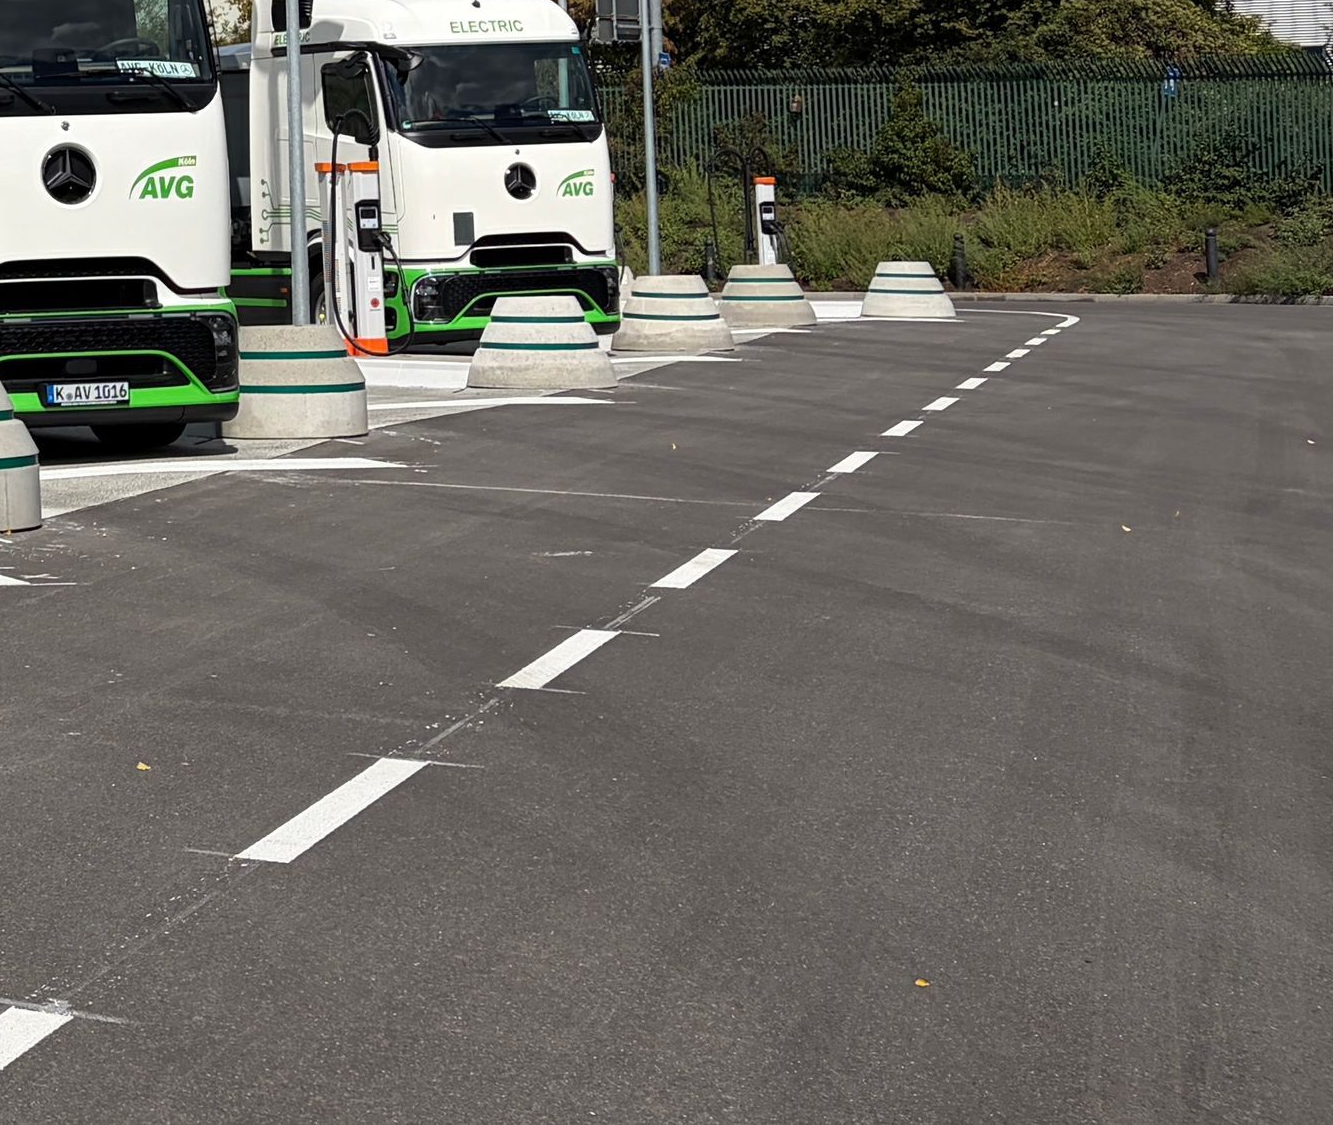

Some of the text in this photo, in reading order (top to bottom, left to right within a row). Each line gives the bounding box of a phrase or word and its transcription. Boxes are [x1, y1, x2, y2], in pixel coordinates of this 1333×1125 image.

[450, 20, 523, 34] ELECTRIC
[139, 175, 194, 199] AVG
[562, 181, 594, 196] AVG
[55, 384, 127, 400] K AV 1016
